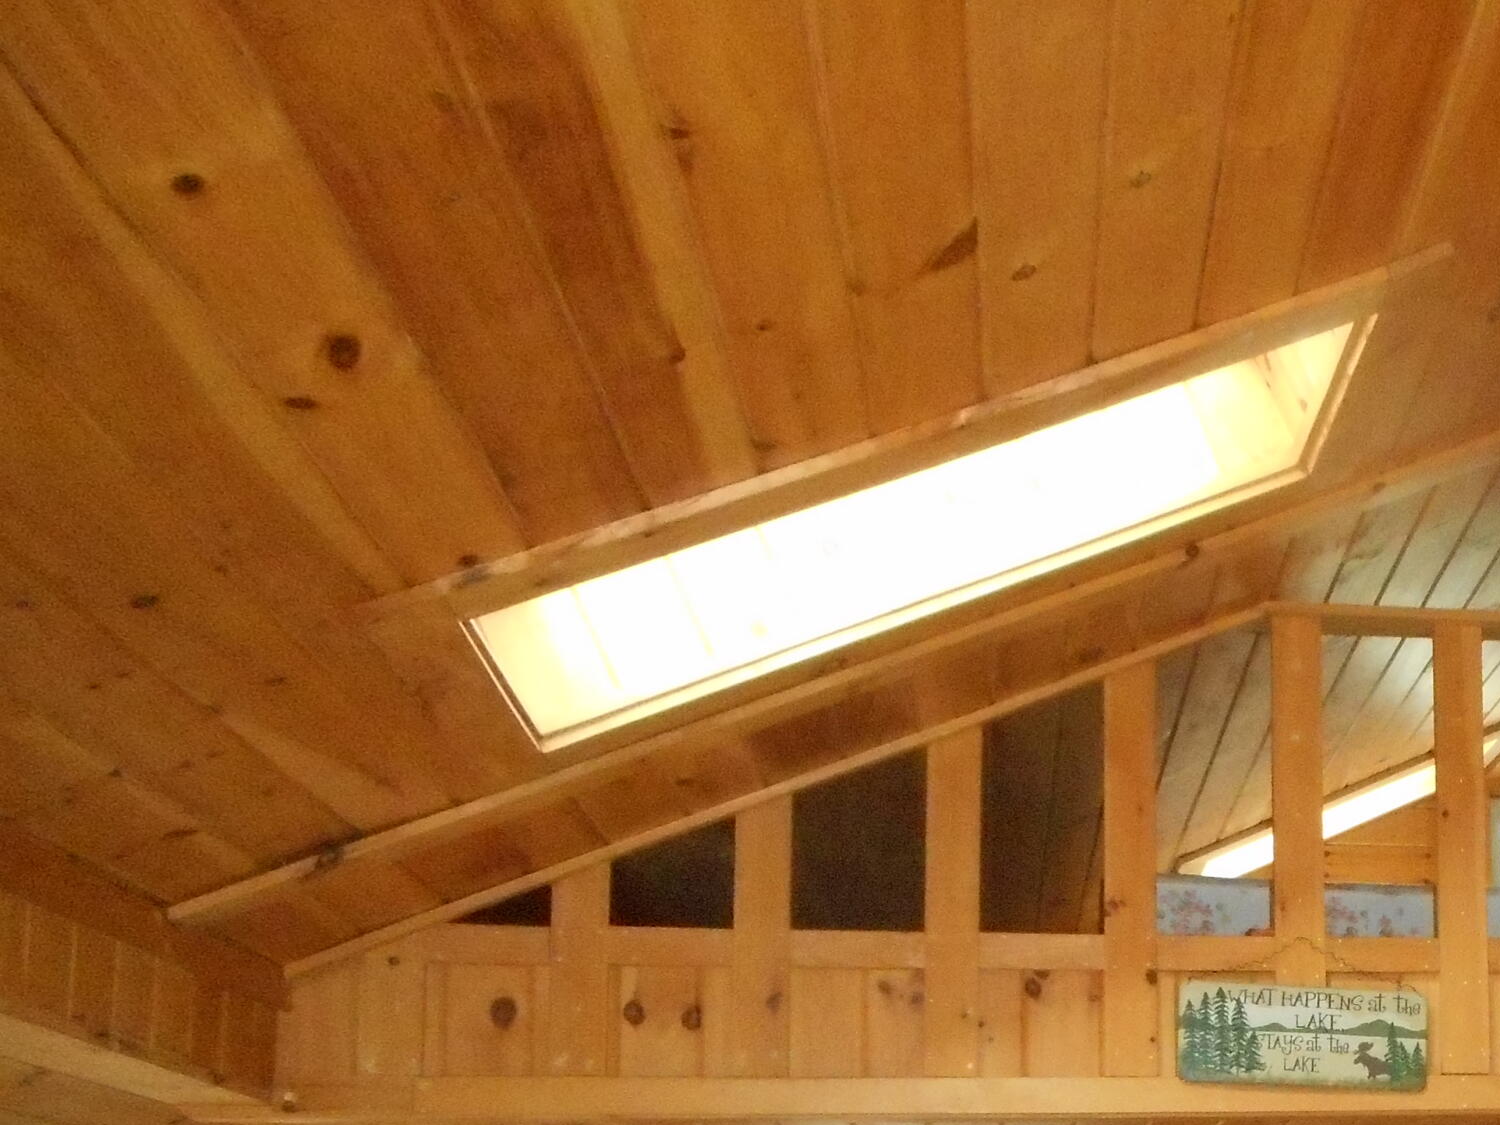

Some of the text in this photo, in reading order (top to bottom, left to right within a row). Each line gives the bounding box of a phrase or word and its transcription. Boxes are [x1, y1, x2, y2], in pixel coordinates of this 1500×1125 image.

[1228, 988, 1421, 1016] WHAT HAPPENS at the
[1306, 1033, 1322, 1053] at
[1327, 1035, 1349, 1054] the
[1283, 1057, 1320, 1073] LAKE
